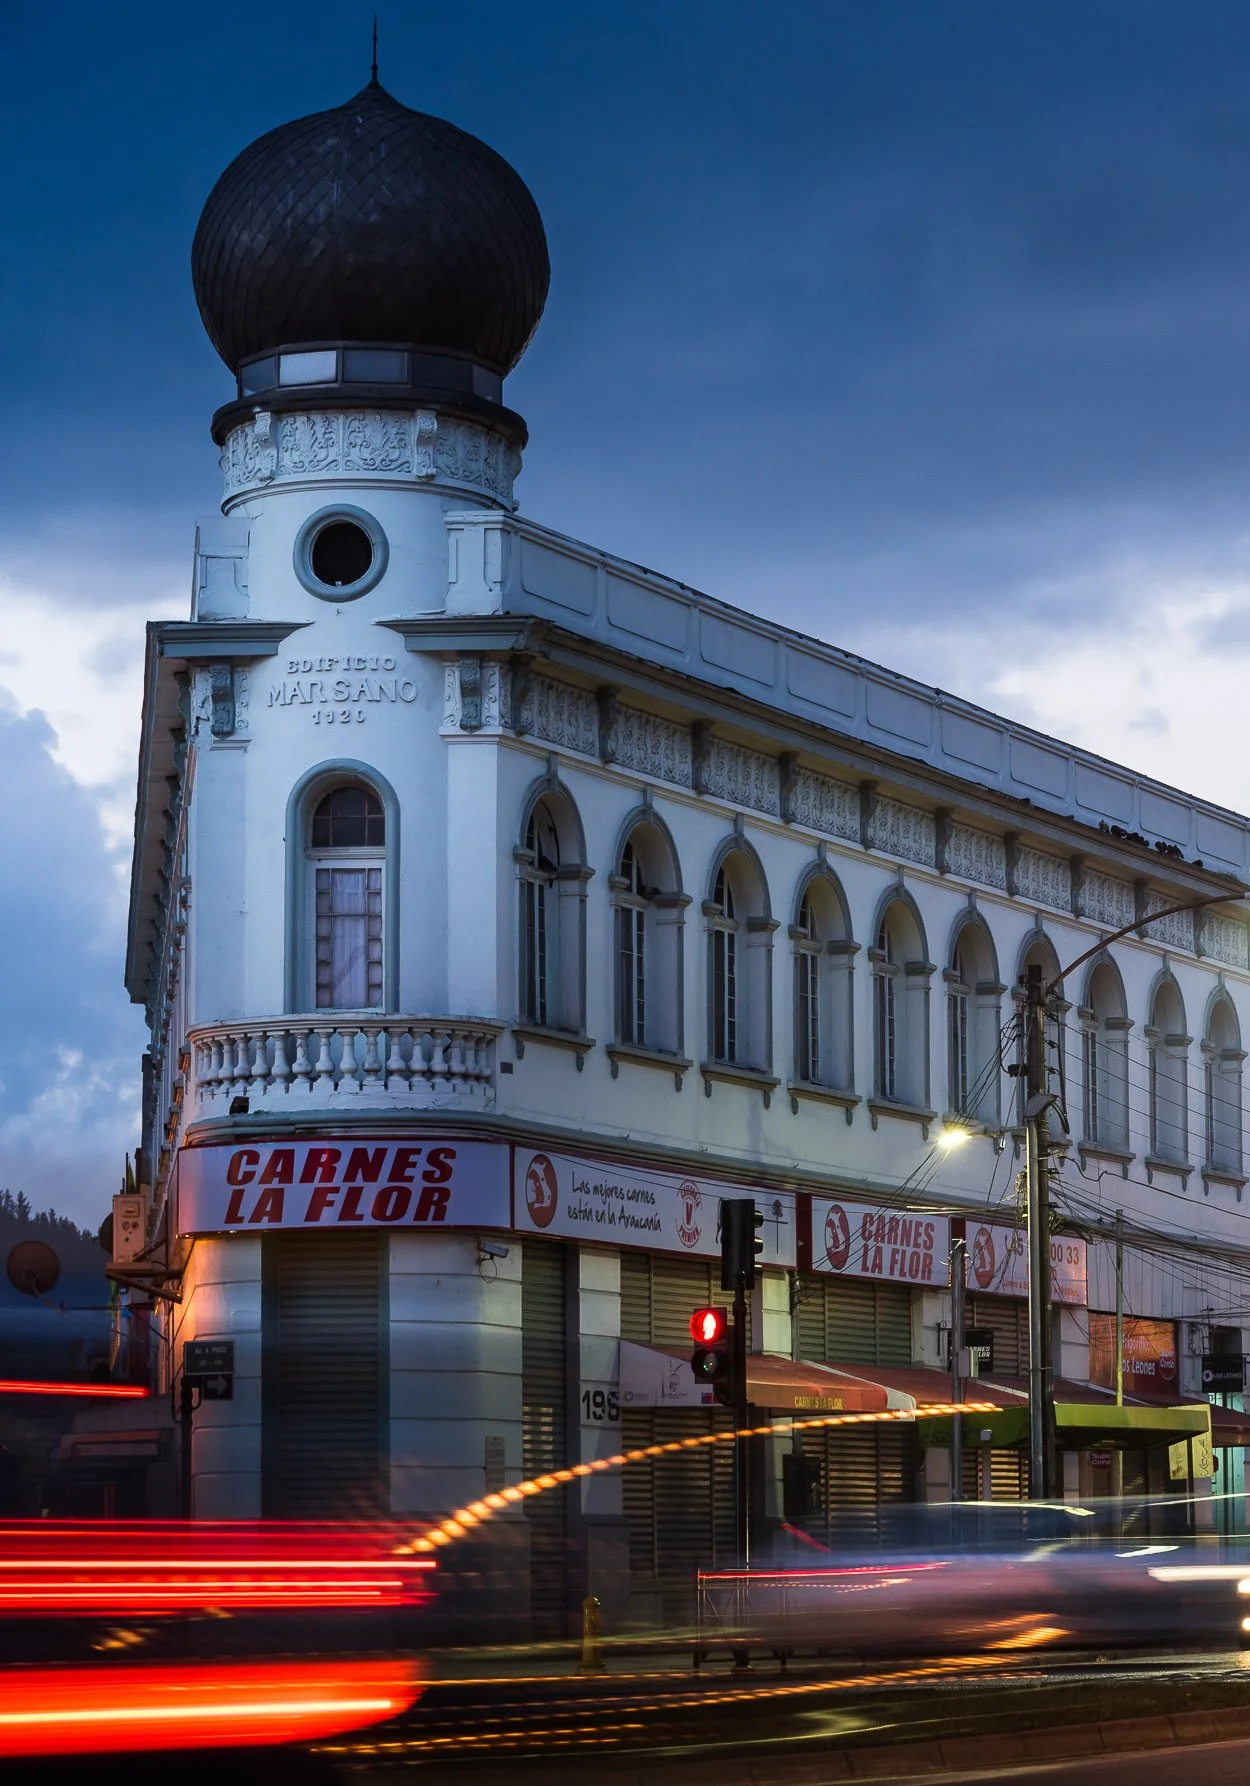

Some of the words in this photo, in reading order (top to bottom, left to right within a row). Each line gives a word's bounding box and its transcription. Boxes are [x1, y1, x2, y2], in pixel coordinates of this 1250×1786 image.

[287, 655, 397, 674] EDIFICIO
[267, 676, 419, 707] MARSANO
[226, 1147, 456, 1186] CARNES
[572, 1170, 590, 1194] Las
[593, 1180, 624, 1205] mejores
[627, 1189, 656, 1205] carnes
[224, 1187, 286, 1224] LA
[304, 1186, 453, 1222] FLOR
[567, 1198, 593, 1222] están
[595, 1208, 606, 1224] en
[608, 1202, 616, 1226] la
[618, 1204, 662, 1232] Araucanía
[861, 1213, 935, 1251] CARNES
[861, 1244, 883, 1275] LA
[889, 1247, 934, 1281] FLOR
[1066, 1246, 1079, 1265] 33
[1122, 1333, 1151, 1354] rigorífico
[1121, 1359, 1129, 1373] os
[1131, 1356, 1155, 1376] Leones
[582, 1390, 619, 1421] 196
[1091, 1452, 1111, 1460] Supe
